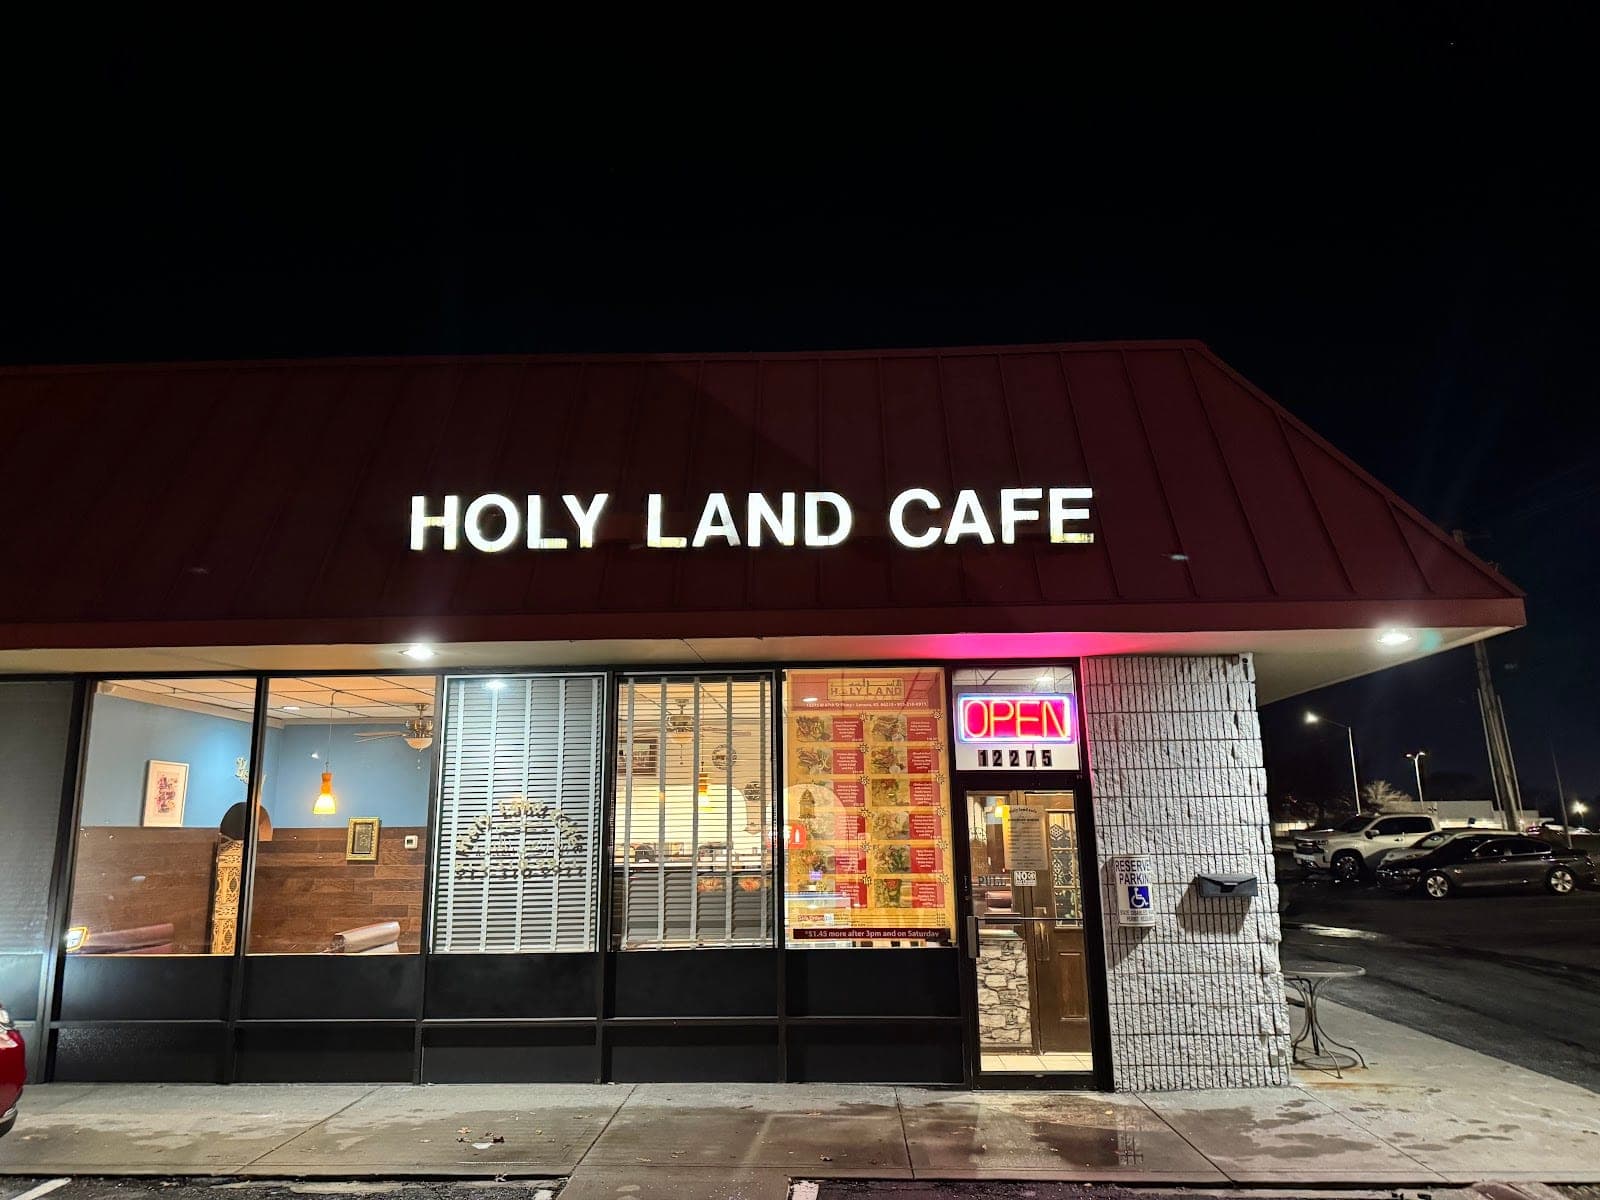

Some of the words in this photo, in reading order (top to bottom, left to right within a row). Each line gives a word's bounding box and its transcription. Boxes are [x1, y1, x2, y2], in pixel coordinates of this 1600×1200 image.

[410, 493, 609, 552] HOLY
[646, 491, 852, 549] LAND
[889, 487, 1095, 549] CAFE
[964, 699, 1070, 739] OPEN
[978, 750, 1052, 767] 12275
[1114, 860, 1151, 872] RESERVE
[1119, 873, 1149, 885] PARKIN
[848, 930, 865, 938] after
[865, 930, 881, 939] 3pm
[882, 930, 896, 938] and
[907, 930, 940, 939] Saturday
